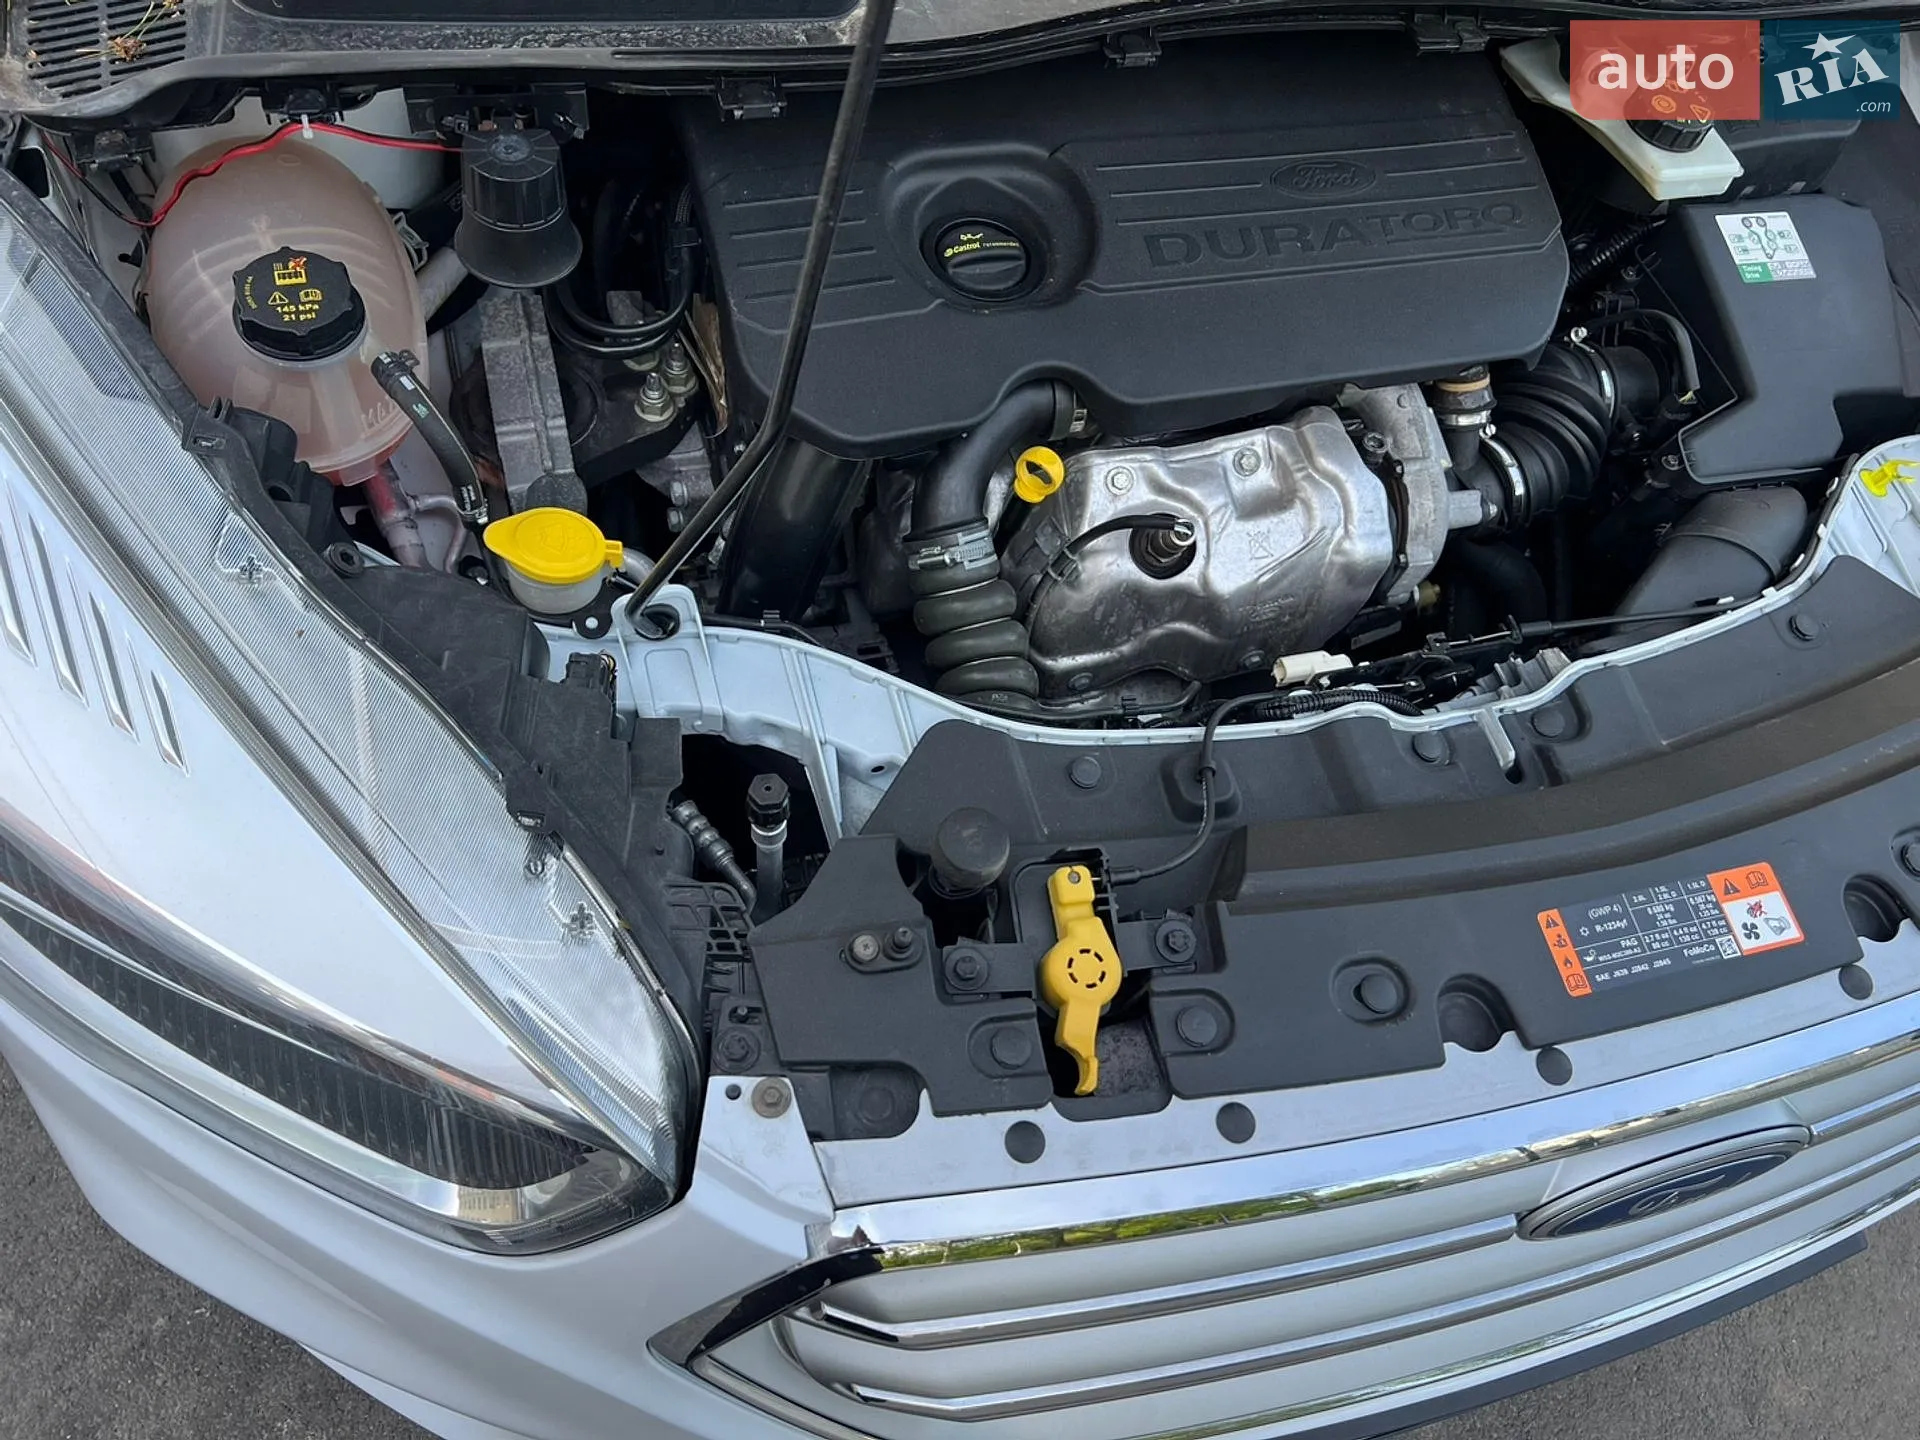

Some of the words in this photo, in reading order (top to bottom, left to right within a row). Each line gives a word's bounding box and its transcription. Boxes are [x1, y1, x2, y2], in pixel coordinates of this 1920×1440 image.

[1292, 162, 1359, 188] Ford
[1143, 203, 1528, 268] DURATORQ
[953, 241, 980, 253] Castrol
[276, 305, 296, 313] 145
[298, 303, 320, 312] kPa
[299, 312, 316, 321] psi
[1588, 905, 1611, 919] (GWP
[1612, 903, 1622, 913] 4)
[1664, 903, 1675, 912] kg
[1594, 918, 1628, 933] R-1234yf
[1620, 937, 1638, 948] PAG
[1683, 943, 1715, 957] FoMoCo
[1595, 972, 1610, 982] SAE
